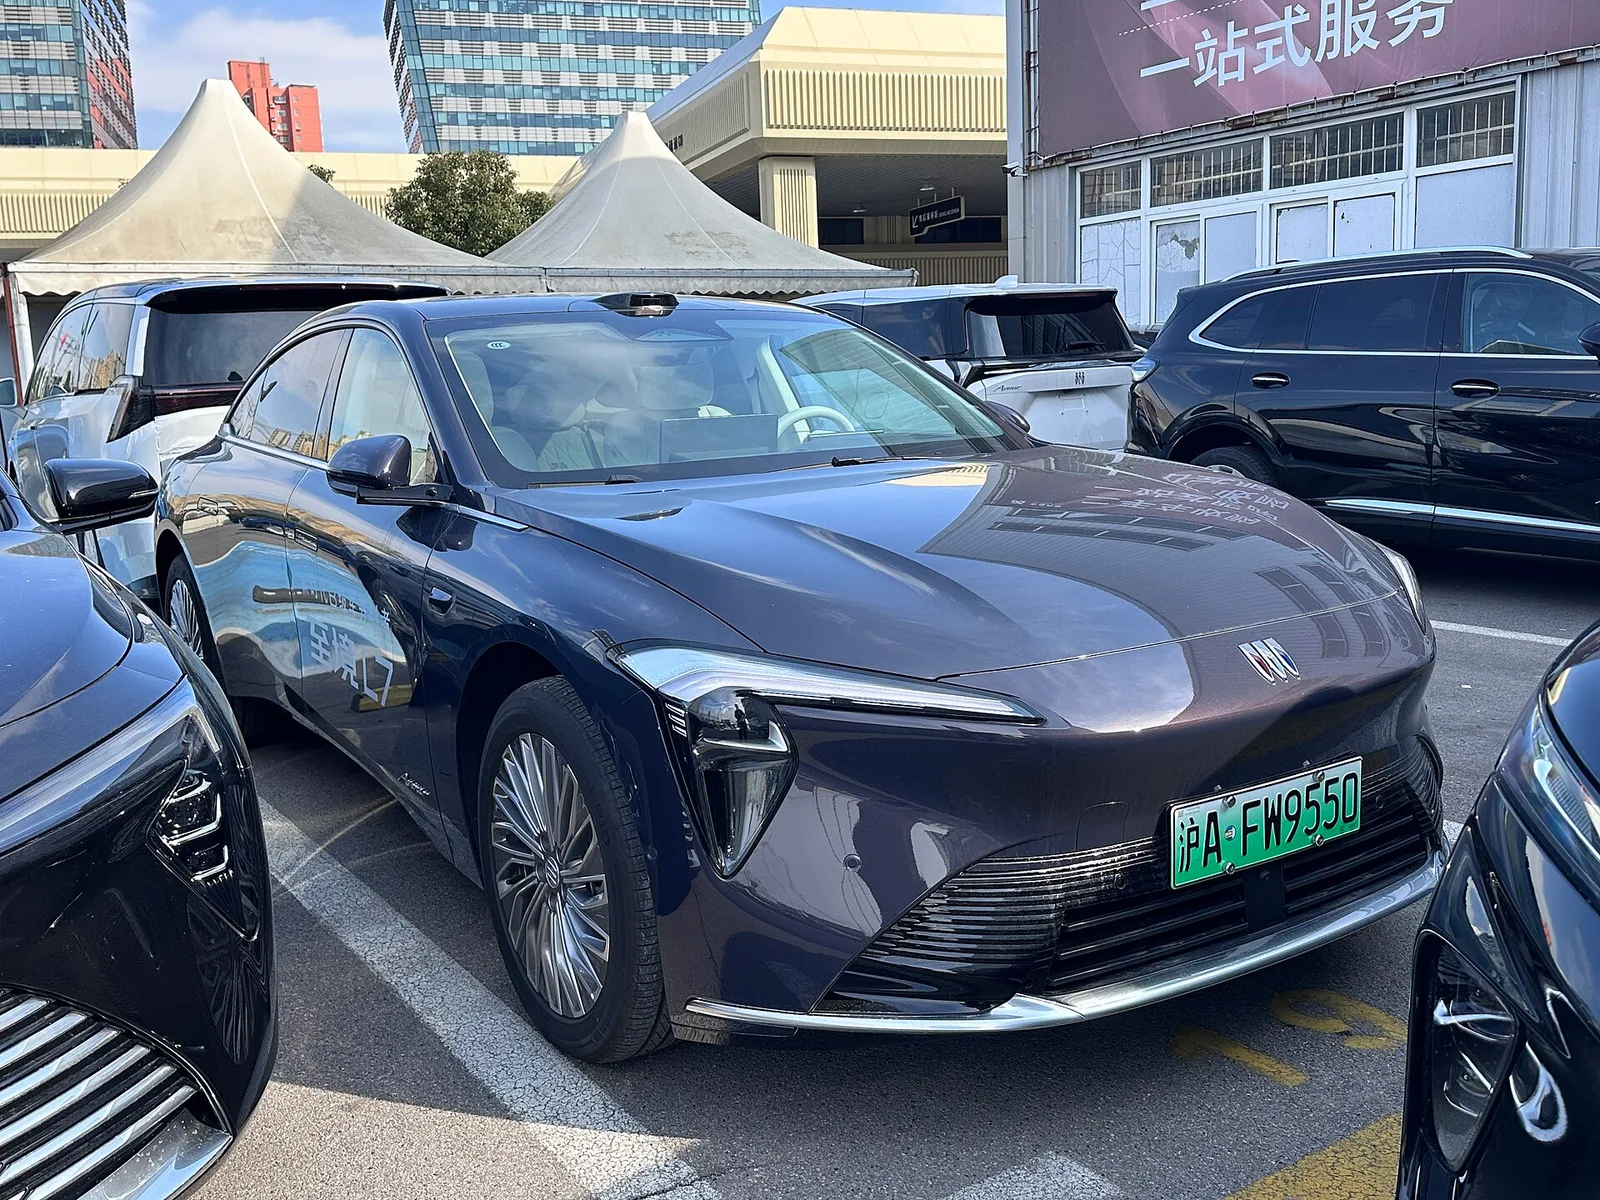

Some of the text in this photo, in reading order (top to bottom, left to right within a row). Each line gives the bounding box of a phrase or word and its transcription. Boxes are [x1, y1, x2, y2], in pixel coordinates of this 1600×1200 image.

[1140, 0, 1453, 87] 一站式服务
[1179, 771, 1358, 874] 沪A FW9550
